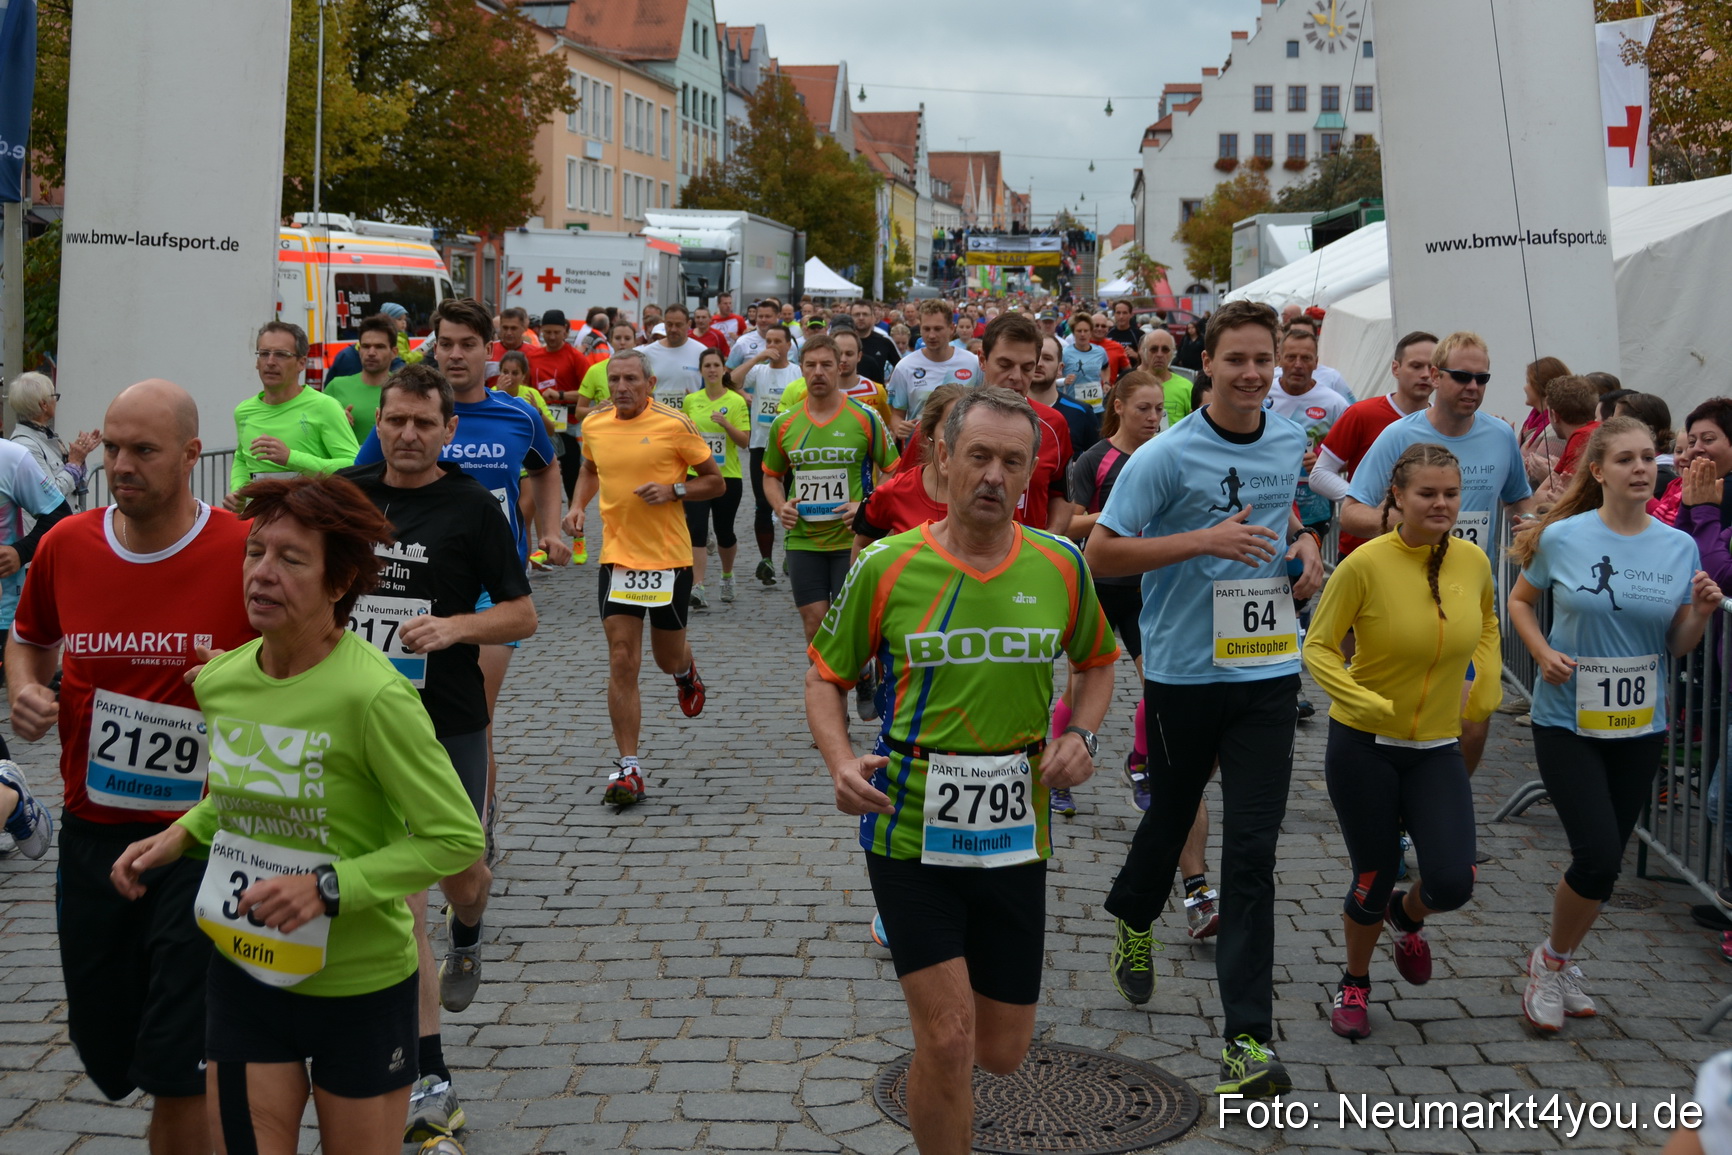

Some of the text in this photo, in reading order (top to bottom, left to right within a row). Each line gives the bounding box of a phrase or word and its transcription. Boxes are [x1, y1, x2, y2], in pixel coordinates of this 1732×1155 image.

[66, 229, 239, 251] www.bmw-laufsport.de
[1425, 228, 1607, 253] www.bmw-laufsport.de
[995, 254, 1029, 263] START
[565, 268, 611, 278] Bayerisches
[565, 277, 587, 285] Rotes
[1081, 389, 1098, 399] 142
[788, 446, 858, 465] BOCK
[1480, 464, 1495, 474] HIP
[1250, 473, 1295, 489] GYM HIP
[800, 481, 844, 501] 2714
[624, 570, 663, 590] 333
[1623, 568, 1673, 585] GYM HIP
[392, 582, 406, 592] km
[1216, 586, 1282, 597] PARTL Neumarkt
[366, 604, 414, 617] Neumarkt
[1243, 600, 1277, 633] 64
[64, 632, 188, 653] NEUMARKT
[905, 626, 1060, 668] BOCK
[1227, 640, 1288, 657] Christopher
[131, 658, 186, 667] STARKE STADT
[1579, 664, 1648, 674] PARTL Neumarkt
[1597, 676, 1646, 707] 108
[96, 699, 192, 731] PARTL Neumarkt
[1607, 714, 1636, 728] Tanja
[97, 720, 200, 774] 2129
[304, 731, 331, 799] 2015
[931, 763, 1019, 778] PARTL Neumarkt
[105, 773, 172, 798] Andreas
[937, 780, 1028, 825] 2793
[951, 832, 1012, 851] Helmuth
[213, 843, 248, 864] PARTL
[233, 935, 275, 965] Karin
